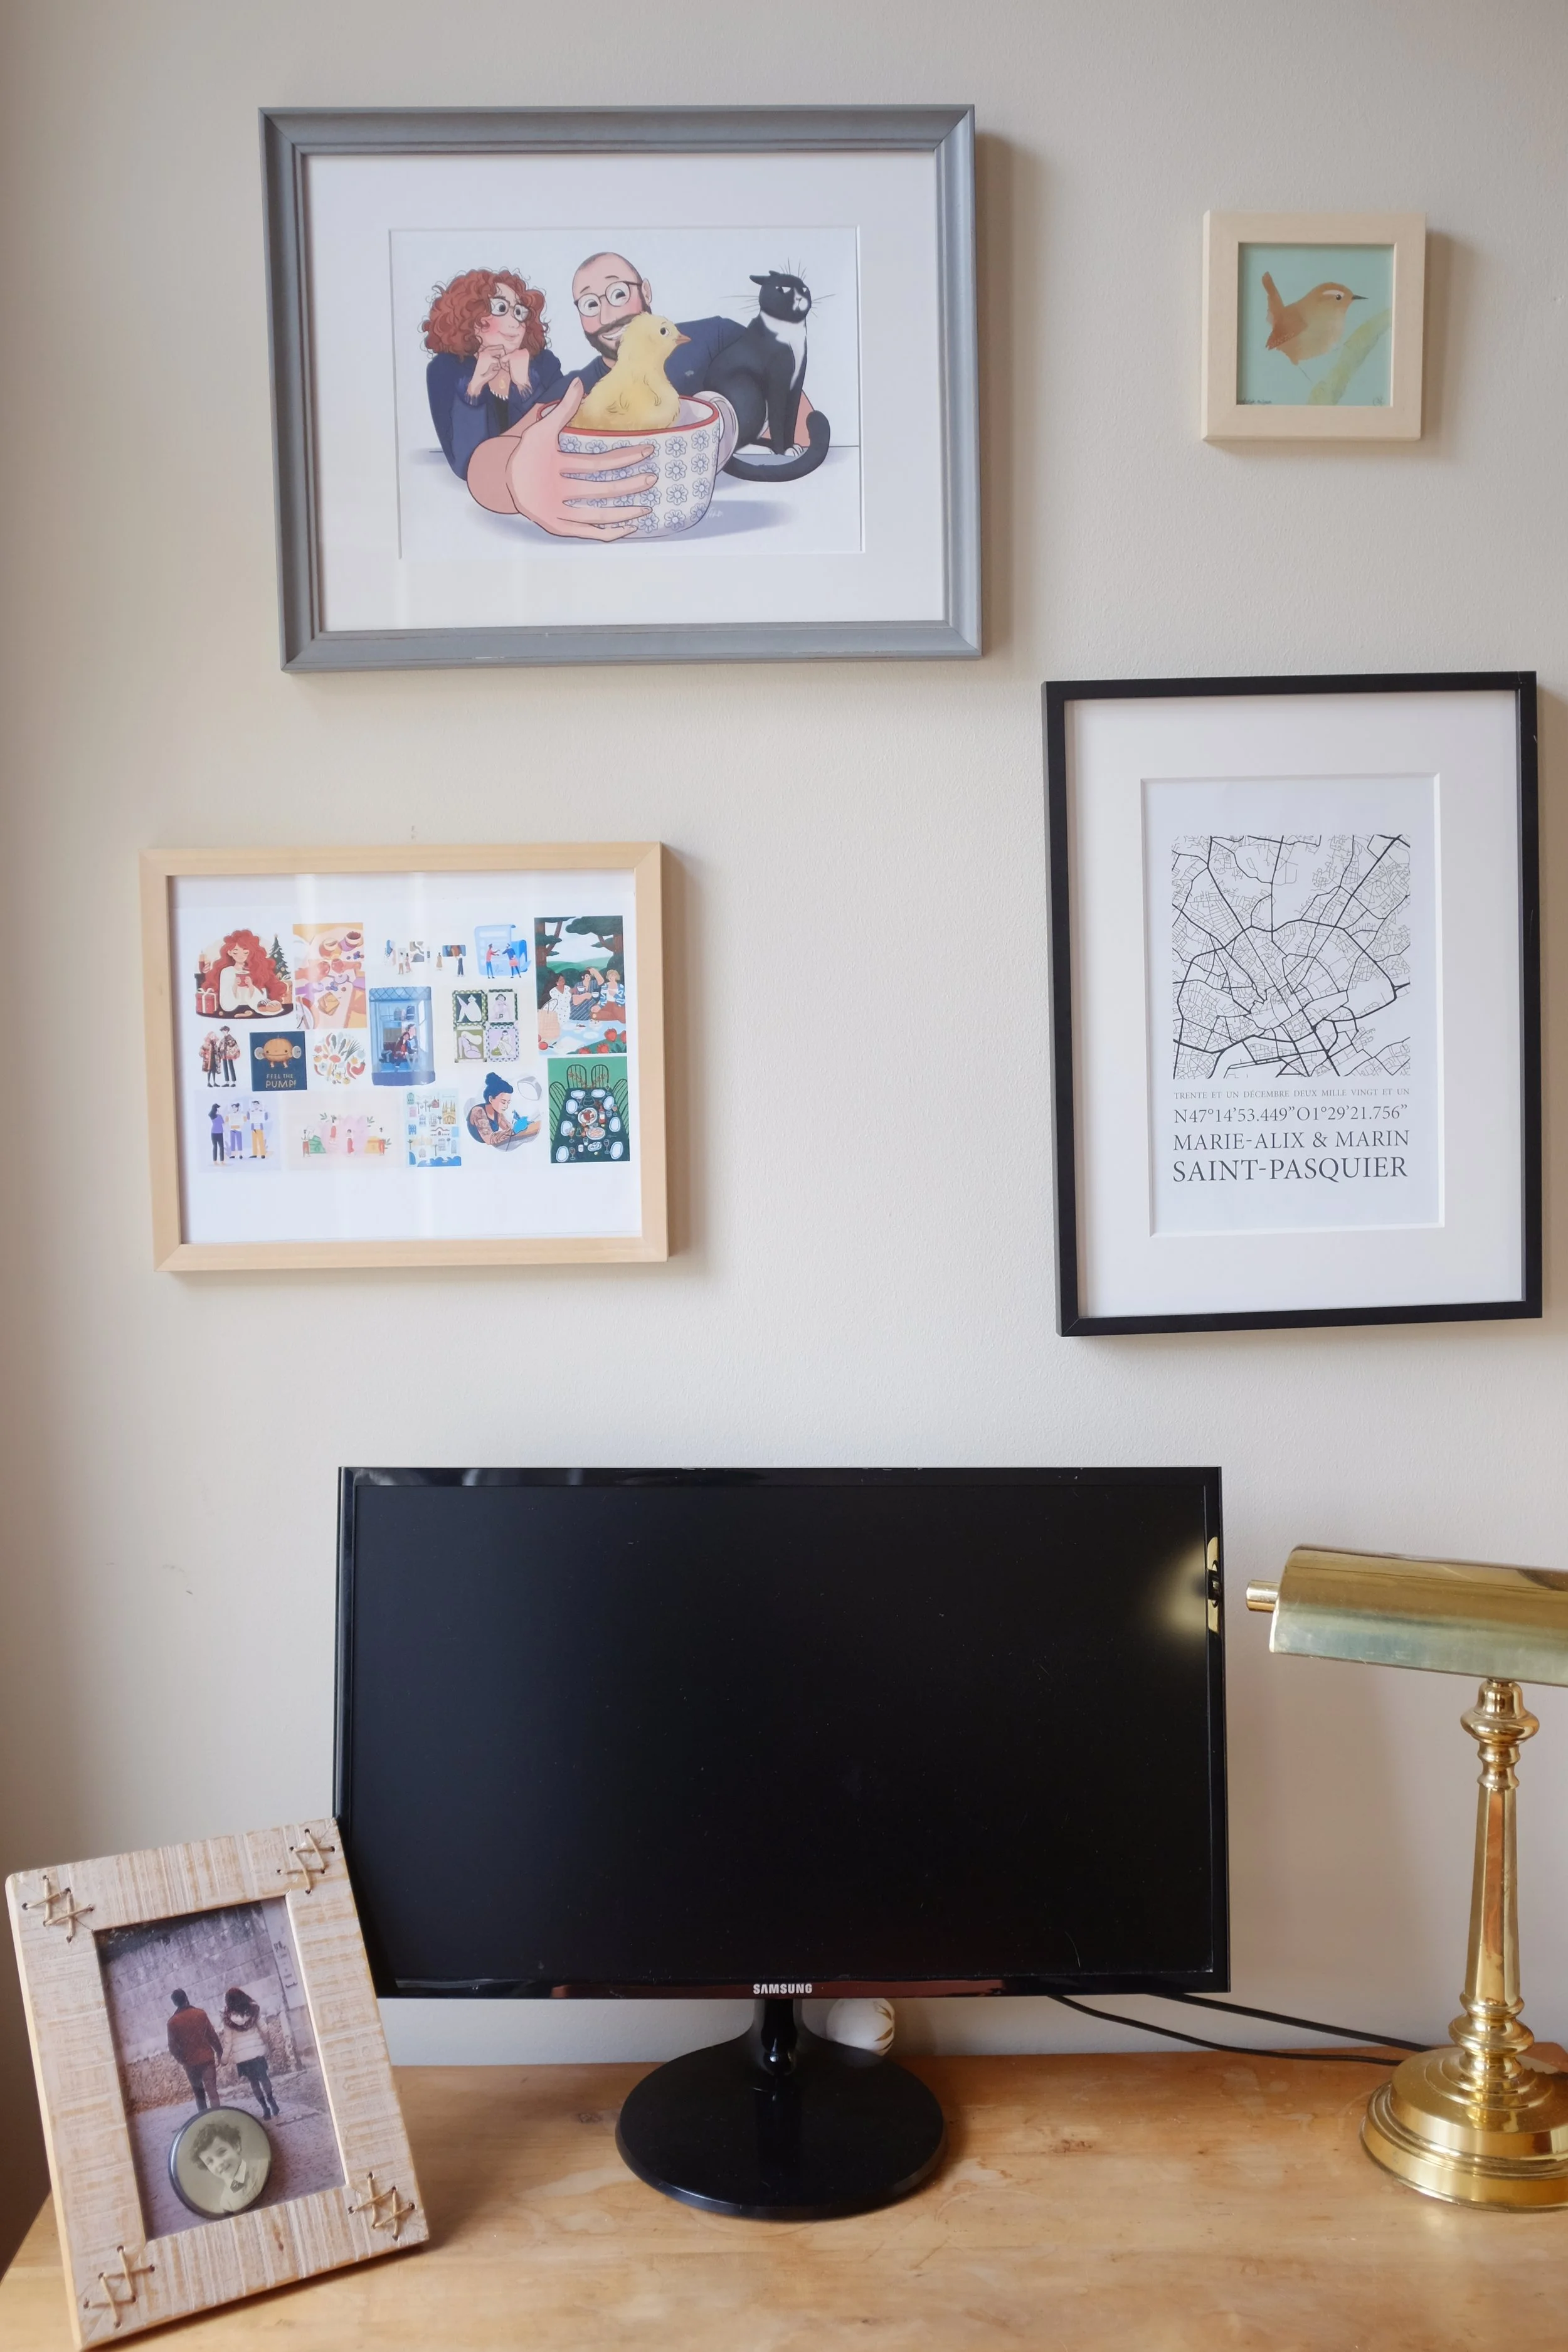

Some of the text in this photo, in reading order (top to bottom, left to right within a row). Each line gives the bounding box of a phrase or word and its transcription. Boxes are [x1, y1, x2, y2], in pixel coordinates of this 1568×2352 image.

[265, 1079, 296, 1088] PUMP!
[1174, 1091, 1207, 1099] TRENTE
[1244, 1089, 1290, 1098] DÉCEMBRE
[1294, 1089, 1318, 1097] DEUX
[1173, 1130, 1409, 1151] MARIE-ALIX & MARIN
[1173, 1156, 1408, 1183] SAINT-PASQUIER
[753, 1983, 813, 1994] SAMSUNG
